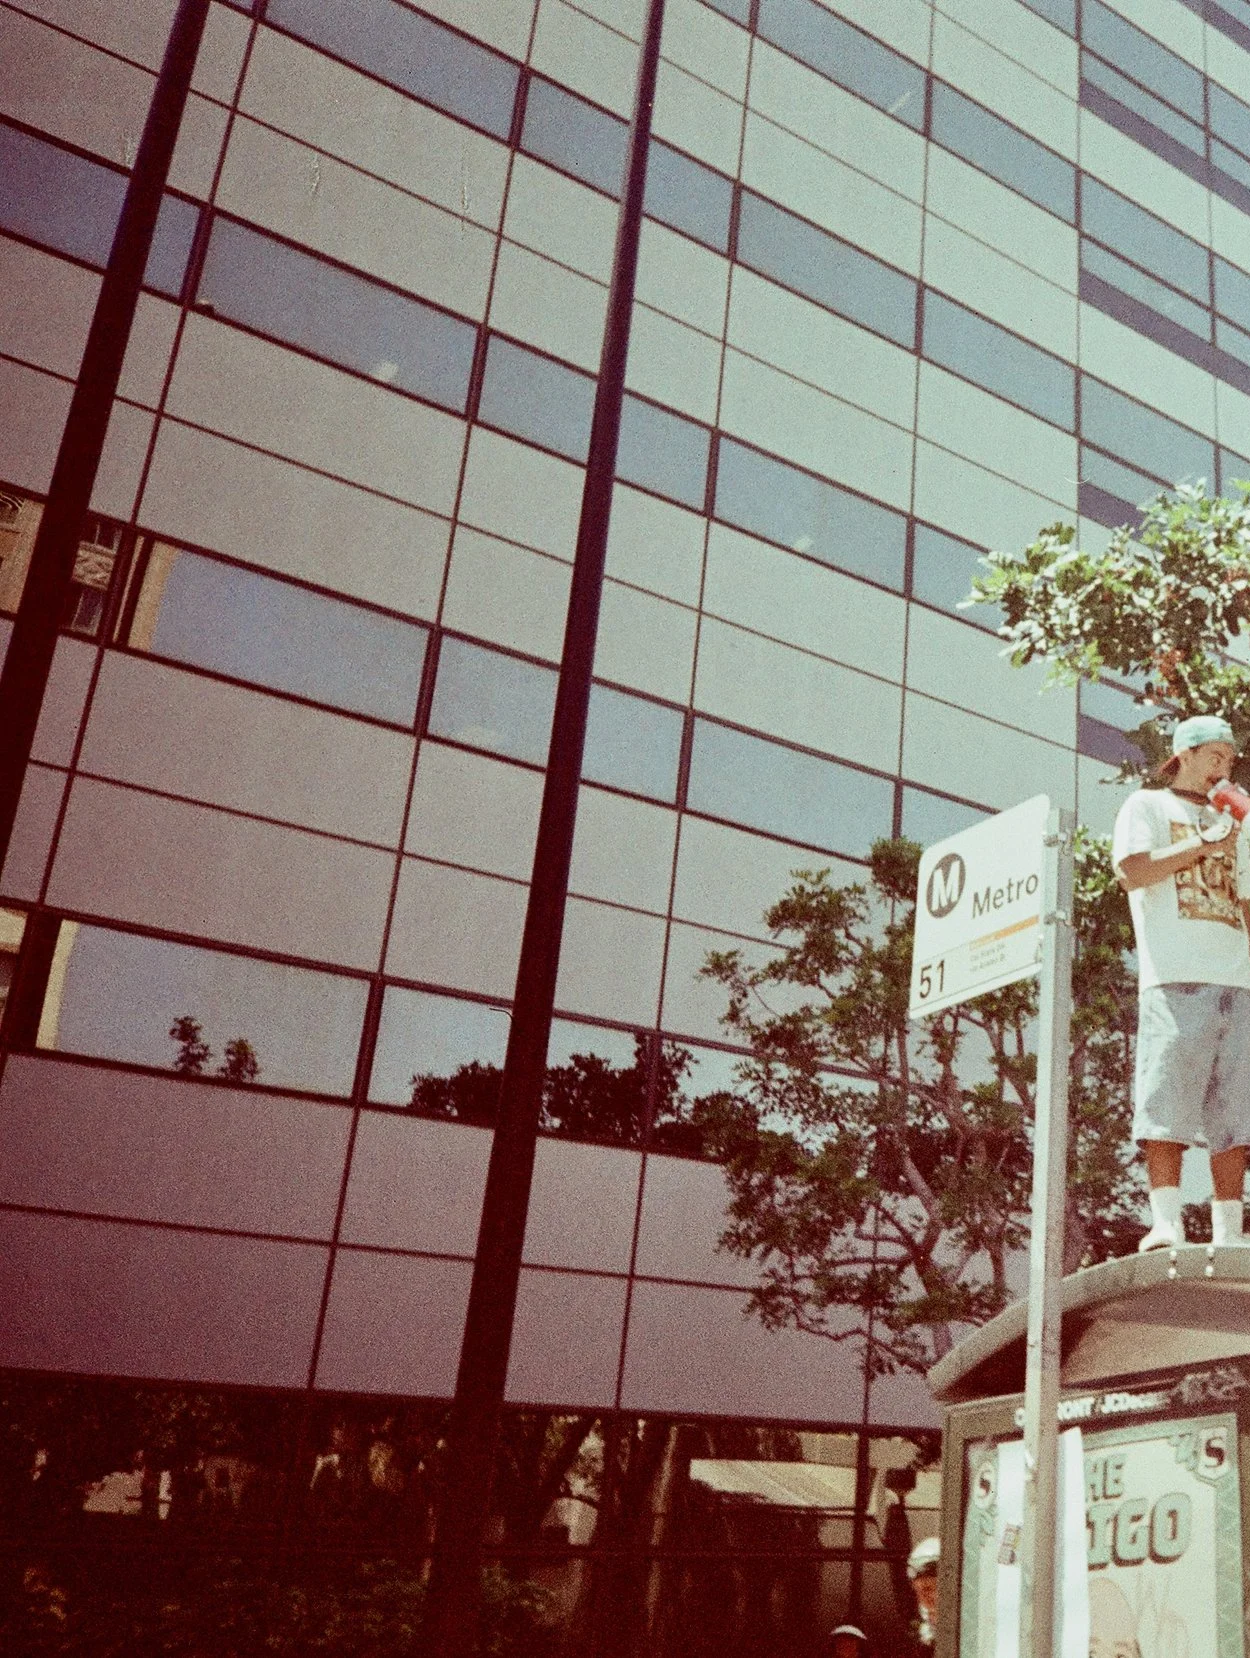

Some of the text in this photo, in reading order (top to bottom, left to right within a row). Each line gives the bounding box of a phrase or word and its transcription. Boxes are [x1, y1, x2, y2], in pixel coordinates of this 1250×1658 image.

[928, 855, 1039, 920] M Metro
[919, 959, 946, 999] 51
[1084, 1453, 1127, 1502] HE
